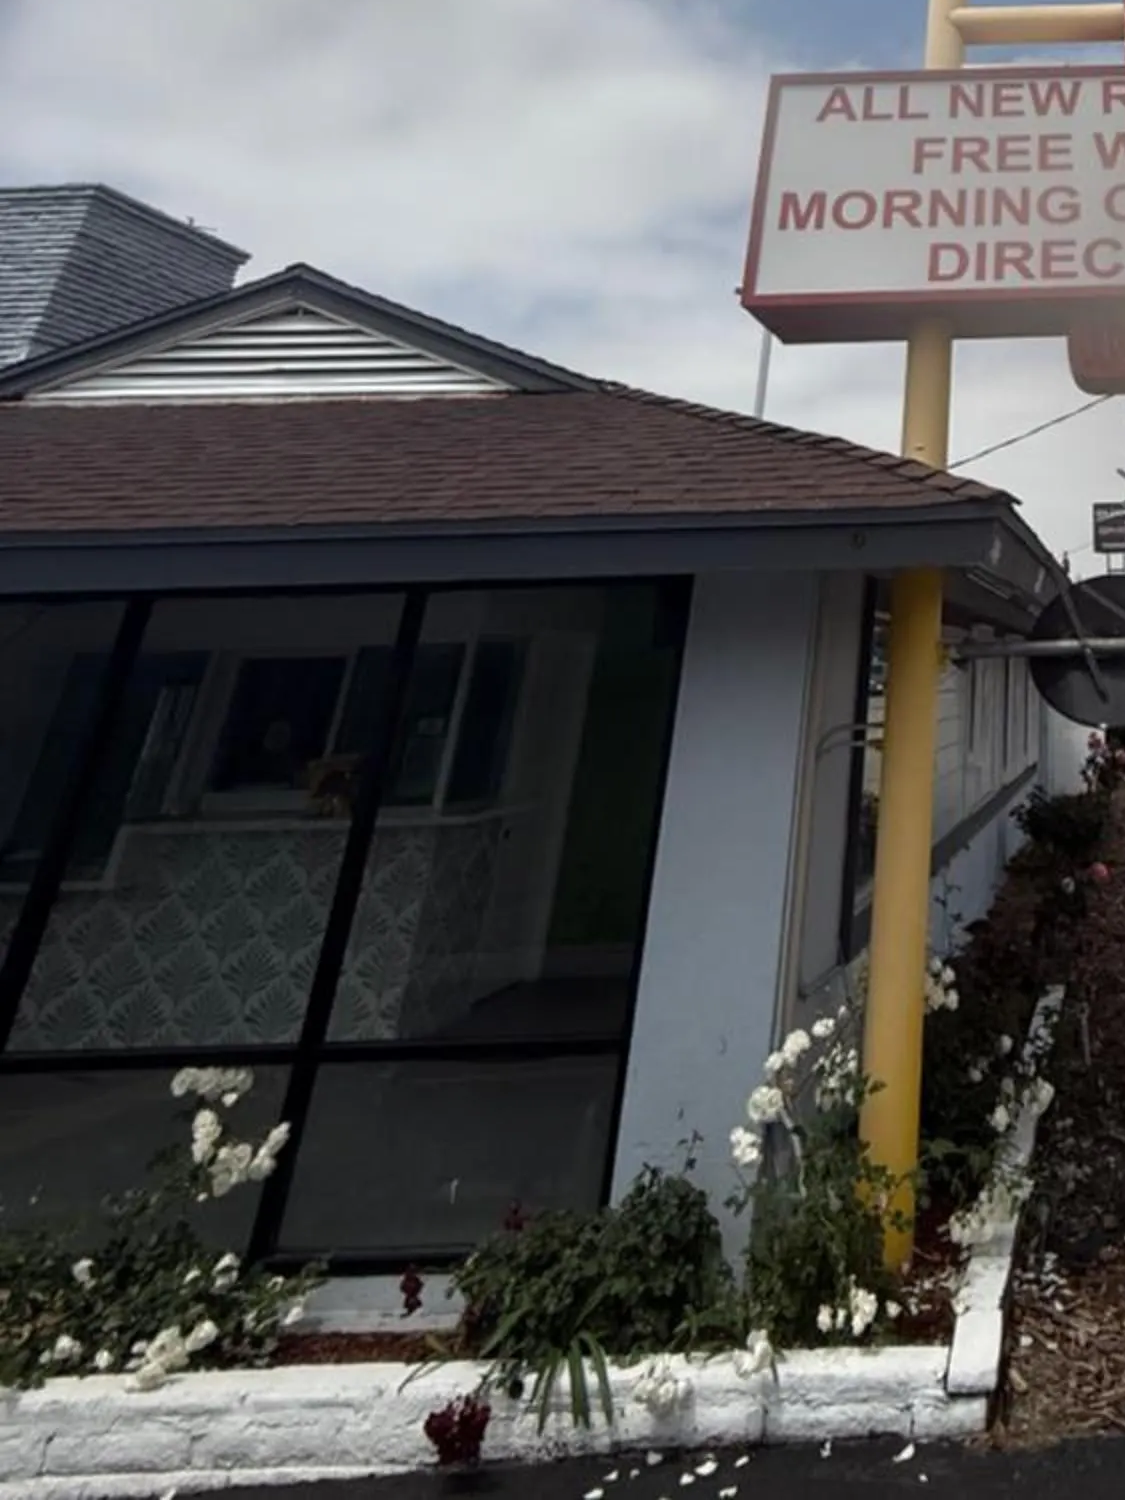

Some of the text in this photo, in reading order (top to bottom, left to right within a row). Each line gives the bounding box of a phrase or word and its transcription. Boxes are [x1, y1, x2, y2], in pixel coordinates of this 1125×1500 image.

[816, 87, 929, 122] ALL
[948, 80, 1081, 118] NEW
[912, 133, 1072, 174] FREE
[776, 186, 1081, 231] MORNING
